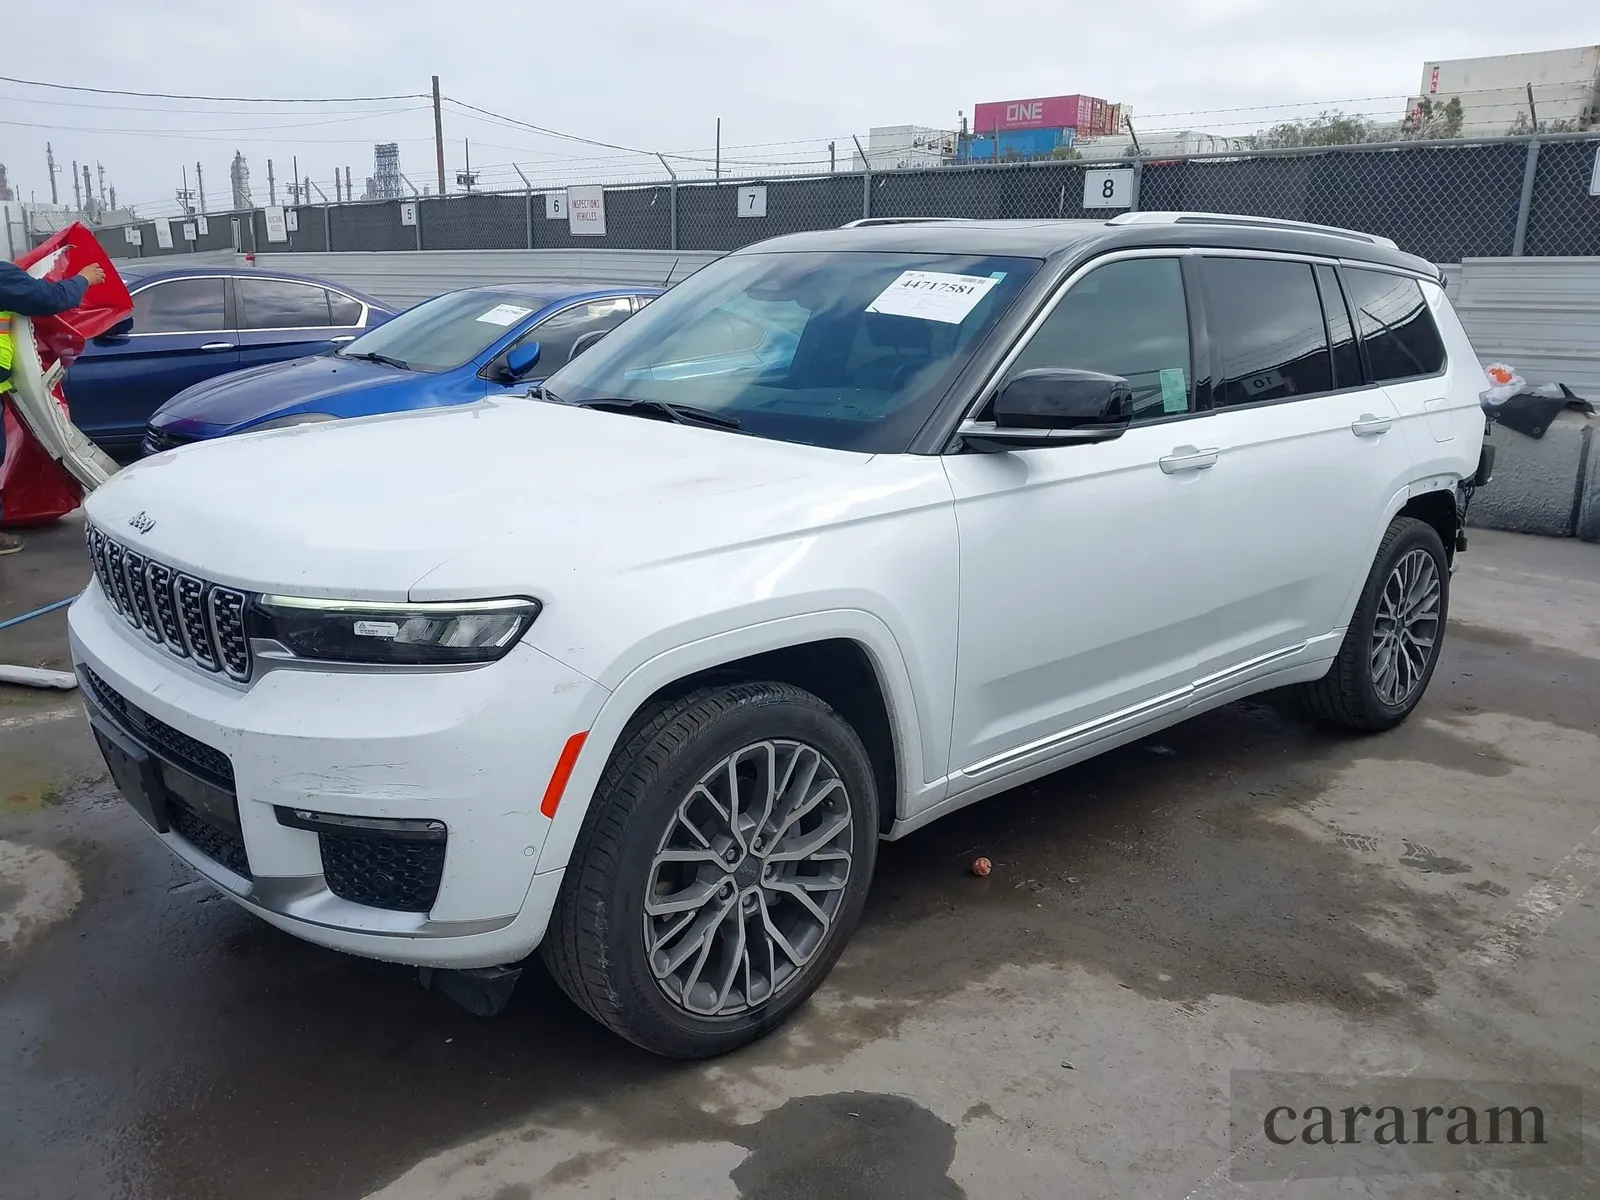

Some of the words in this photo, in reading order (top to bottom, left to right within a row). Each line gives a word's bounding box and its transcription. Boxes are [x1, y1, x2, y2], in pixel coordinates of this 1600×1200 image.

[1006, 102, 1043, 121] ONE
[1102, 178, 1114, 198] 8
[553, 199, 560, 213] 6
[571, 199, 600, 209] INSPECTIONS
[748, 194, 756, 210] 7
[407, 208, 412, 220] 5
[575, 211, 597, 222] VEHICLES
[901, 279, 977, 296] 44717581
[128, 509, 157, 535] Jeep
